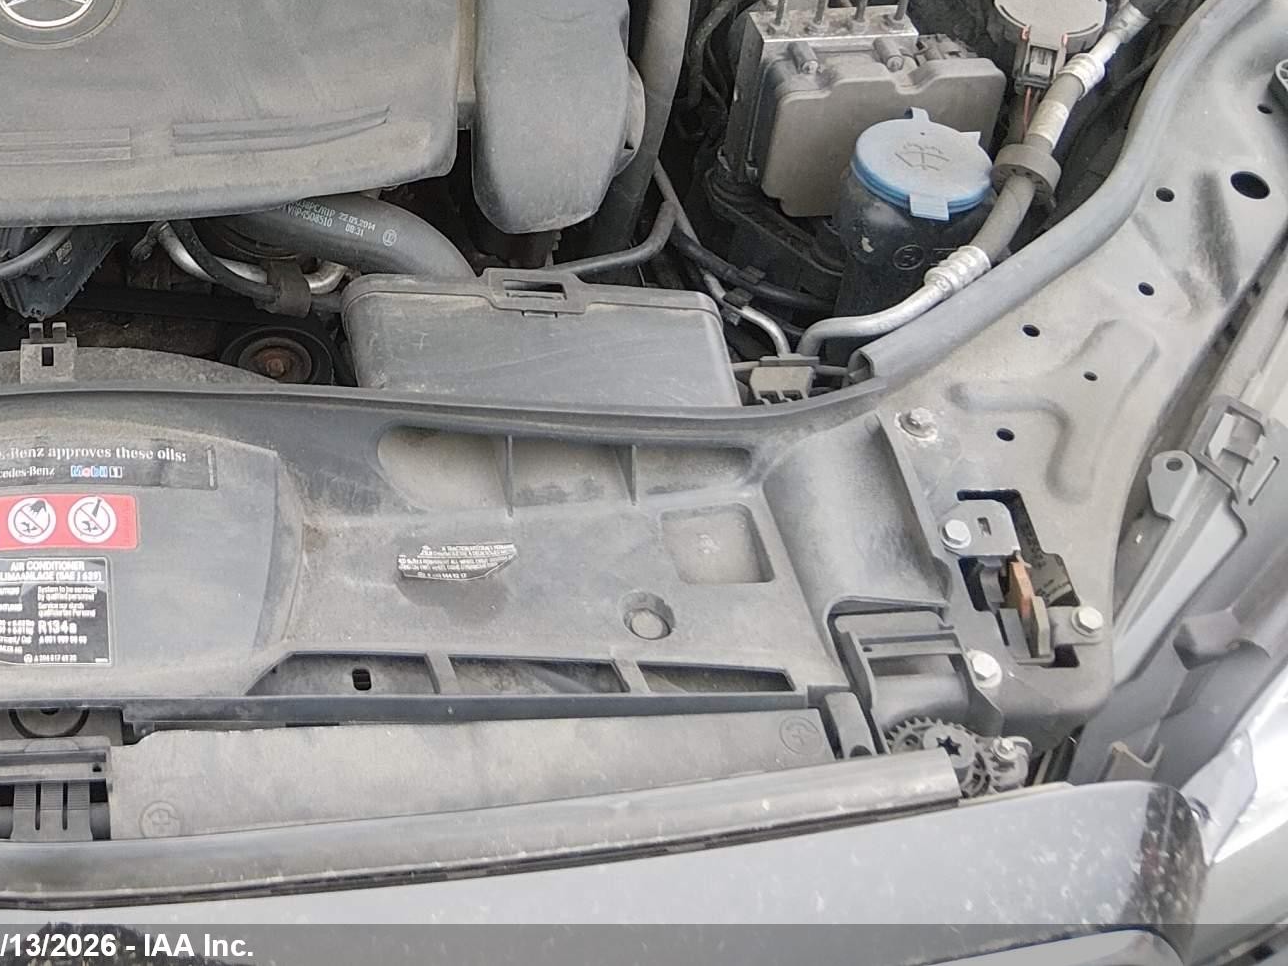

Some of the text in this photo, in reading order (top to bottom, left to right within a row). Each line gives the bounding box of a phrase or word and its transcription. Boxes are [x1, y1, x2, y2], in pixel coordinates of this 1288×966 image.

[48, 447, 111, 461] approves
[115, 447, 154, 461] these
[157, 448, 187, 462] oils:
[70, 465, 108, 478] Mobil
[10, 561, 85, 572] AIR CONDITIONER
[37, 620, 78, 635] R134a
